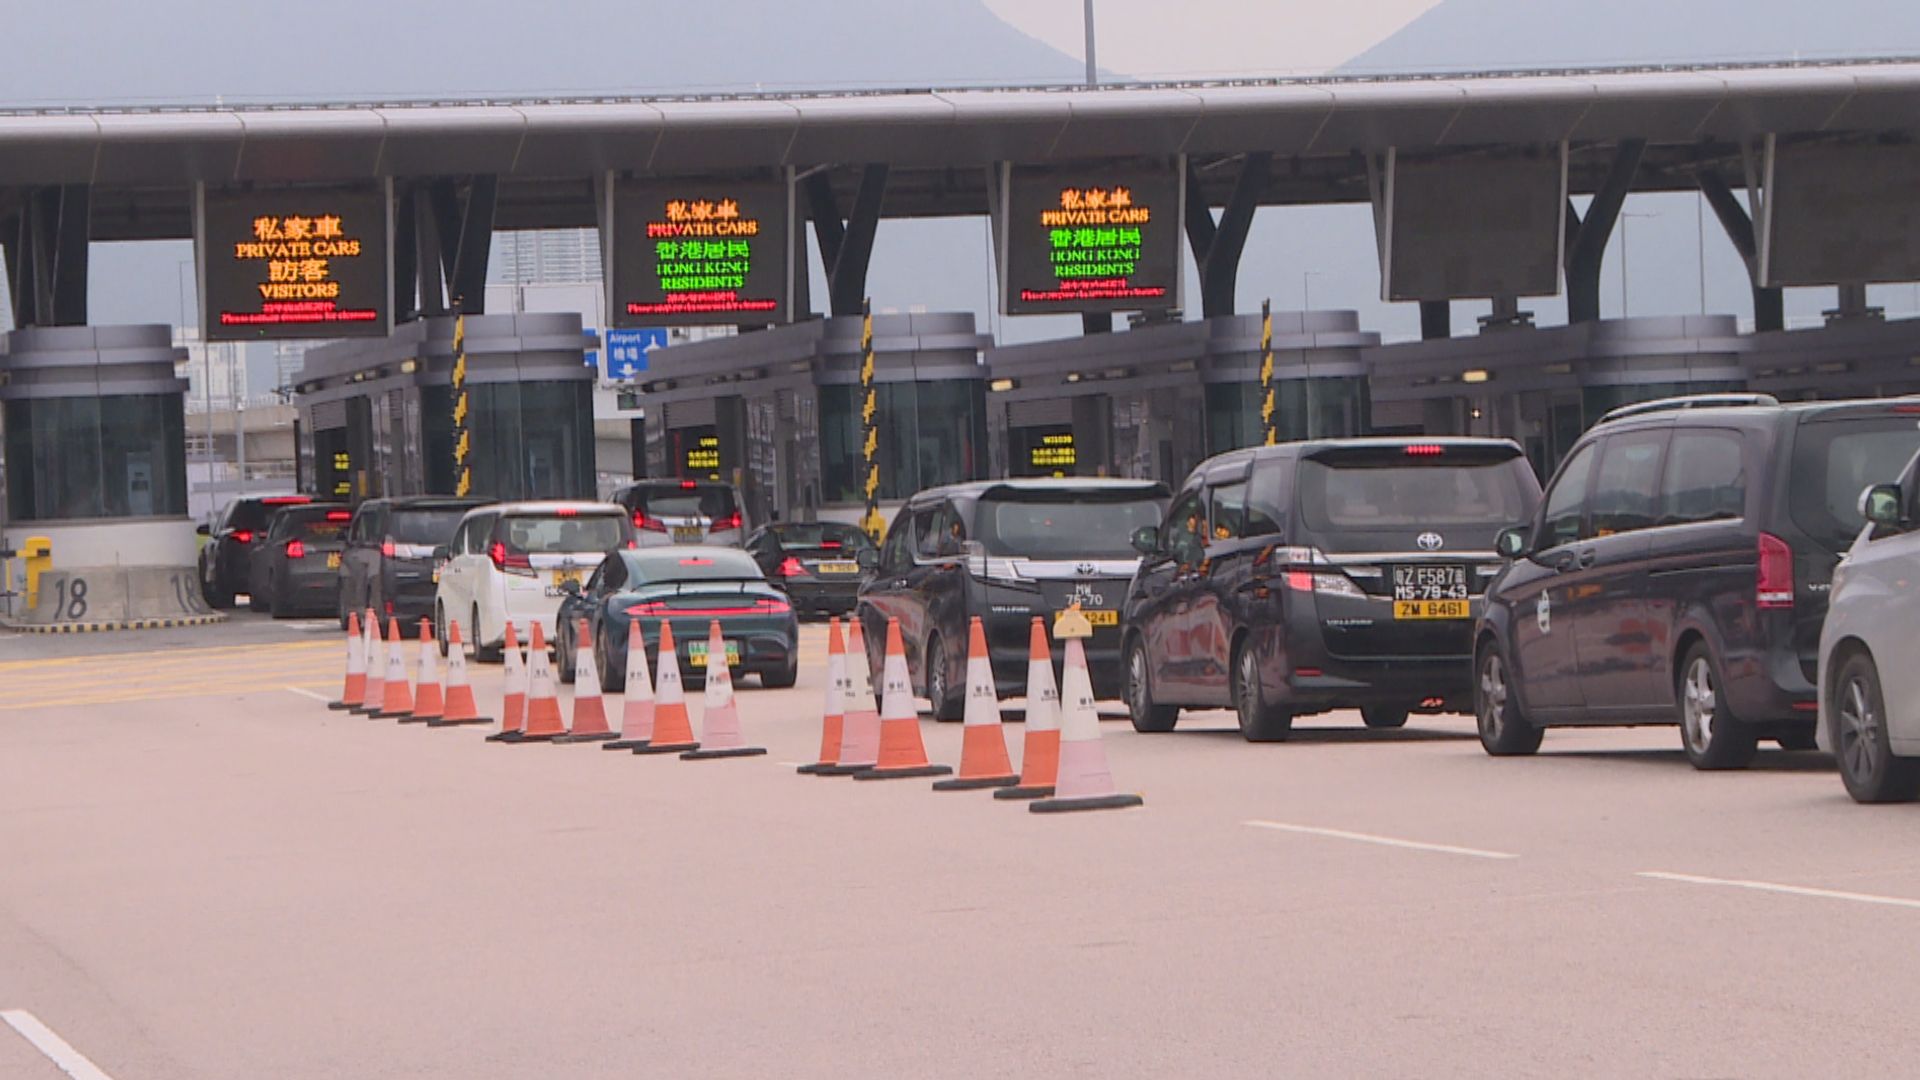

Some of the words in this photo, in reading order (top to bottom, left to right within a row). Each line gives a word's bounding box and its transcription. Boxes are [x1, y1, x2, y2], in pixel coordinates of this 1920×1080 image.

[1061, 187, 1131, 211] 私家車
[667, 198, 738, 222] 私家車
[1042, 211, 1106, 225] PRIVATE
[1109, 208, 1149, 223] CARS
[254, 215, 343, 241] 私家車
[648, 222, 713, 237] PRIVATE
[716, 220, 758, 236] CARS
[1049, 227, 1141, 247] 香港居民
[237, 243, 310, 258] PRIVATE
[313, 241, 361, 256] CARS
[655, 240, 750, 260] 香港居民
[1051, 249, 1093, 262] HONG
[1097, 248, 1140, 261] KONG
[268, 259, 329, 282] 訪客
[656, 262, 700, 275] HONG
[704, 261, 749, 274] KONG
[1055, 262, 1134, 277] RESIDENTS
[259, 283, 339, 299] VISITORS
[661, 275, 744, 290] RESIDENTS
[609, 333, 640, 345] Airport
[170, 573, 201, 614] 18
[1075, 583, 1092, 595] MW
[54, 577, 88, 620] 18
[1401, 602, 1421, 616] ZM
[1427, 602, 1463, 616] 6461
